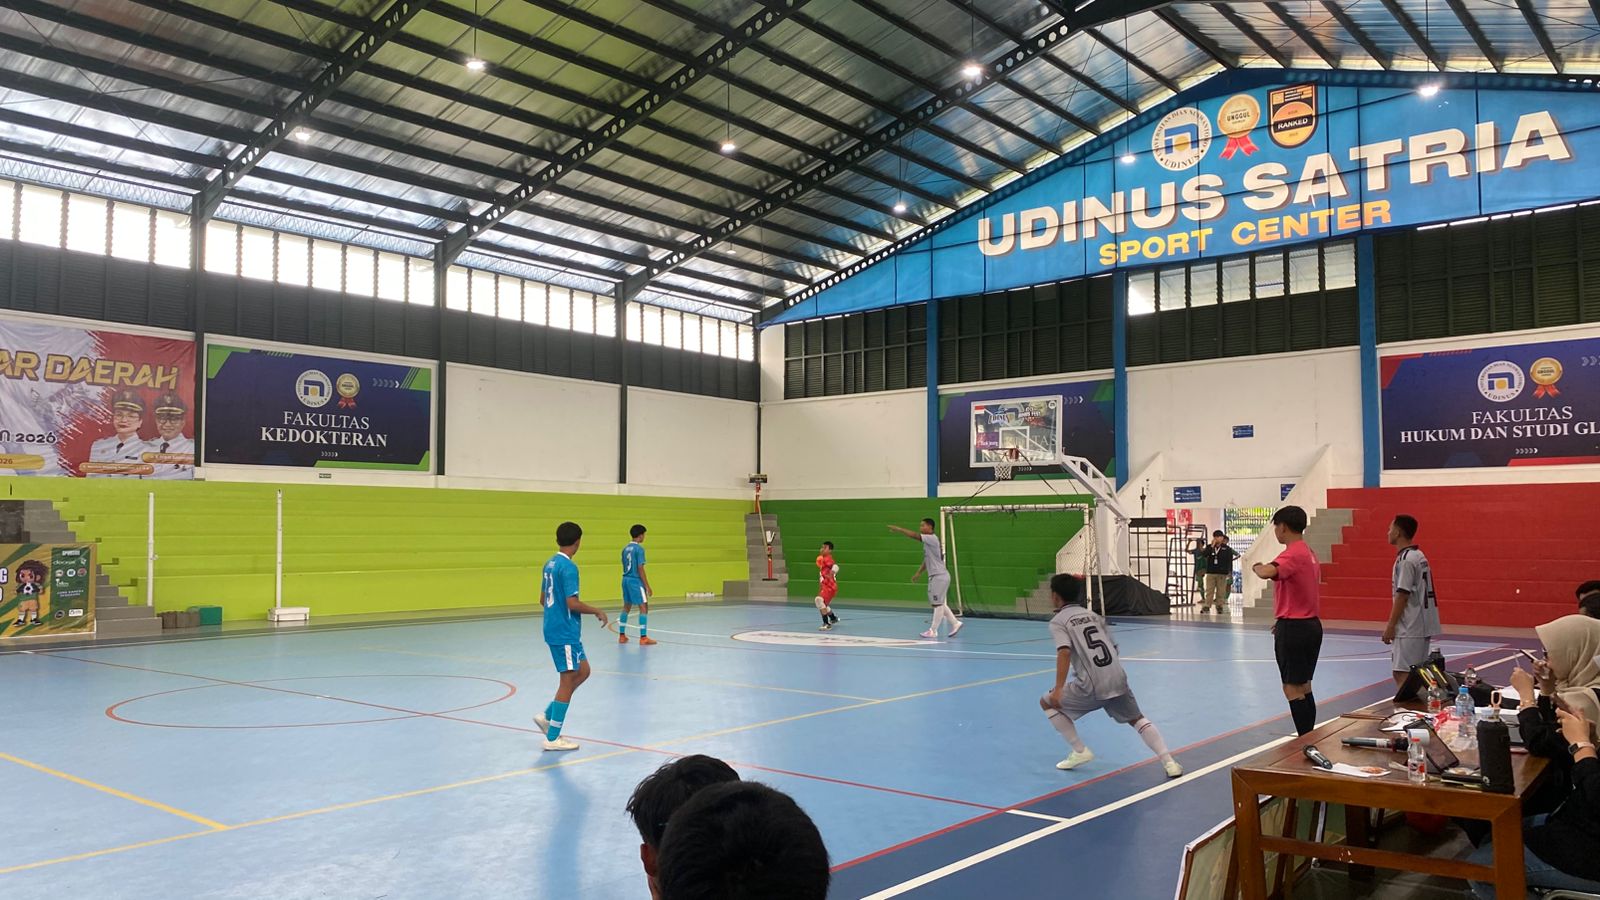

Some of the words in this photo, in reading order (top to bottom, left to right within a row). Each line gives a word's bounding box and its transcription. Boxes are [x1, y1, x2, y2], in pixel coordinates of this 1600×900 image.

[1277, 117, 1309, 130] RANKED
[977, 171, 1225, 258] UDINUS
[1242, 110, 1571, 211] SATRIA
[1098, 227, 1213, 266] SPORT
[1231, 199, 1391, 245] CENTER
[44, 353, 180, 391] DAERAH
[283, 411, 370, 430] FAKULTAS
[1471, 405, 1574, 425] FAKULTAS
[15, 431, 57, 444] 2026
[260, 427, 388, 448] KEDOKTERAN
[1400, 428, 1466, 443] HUKUM
[1469, 425, 1508, 440] DAN
[1513, 422, 1569, 438] STUDI
[1082, 625, 1113, 668] 5
